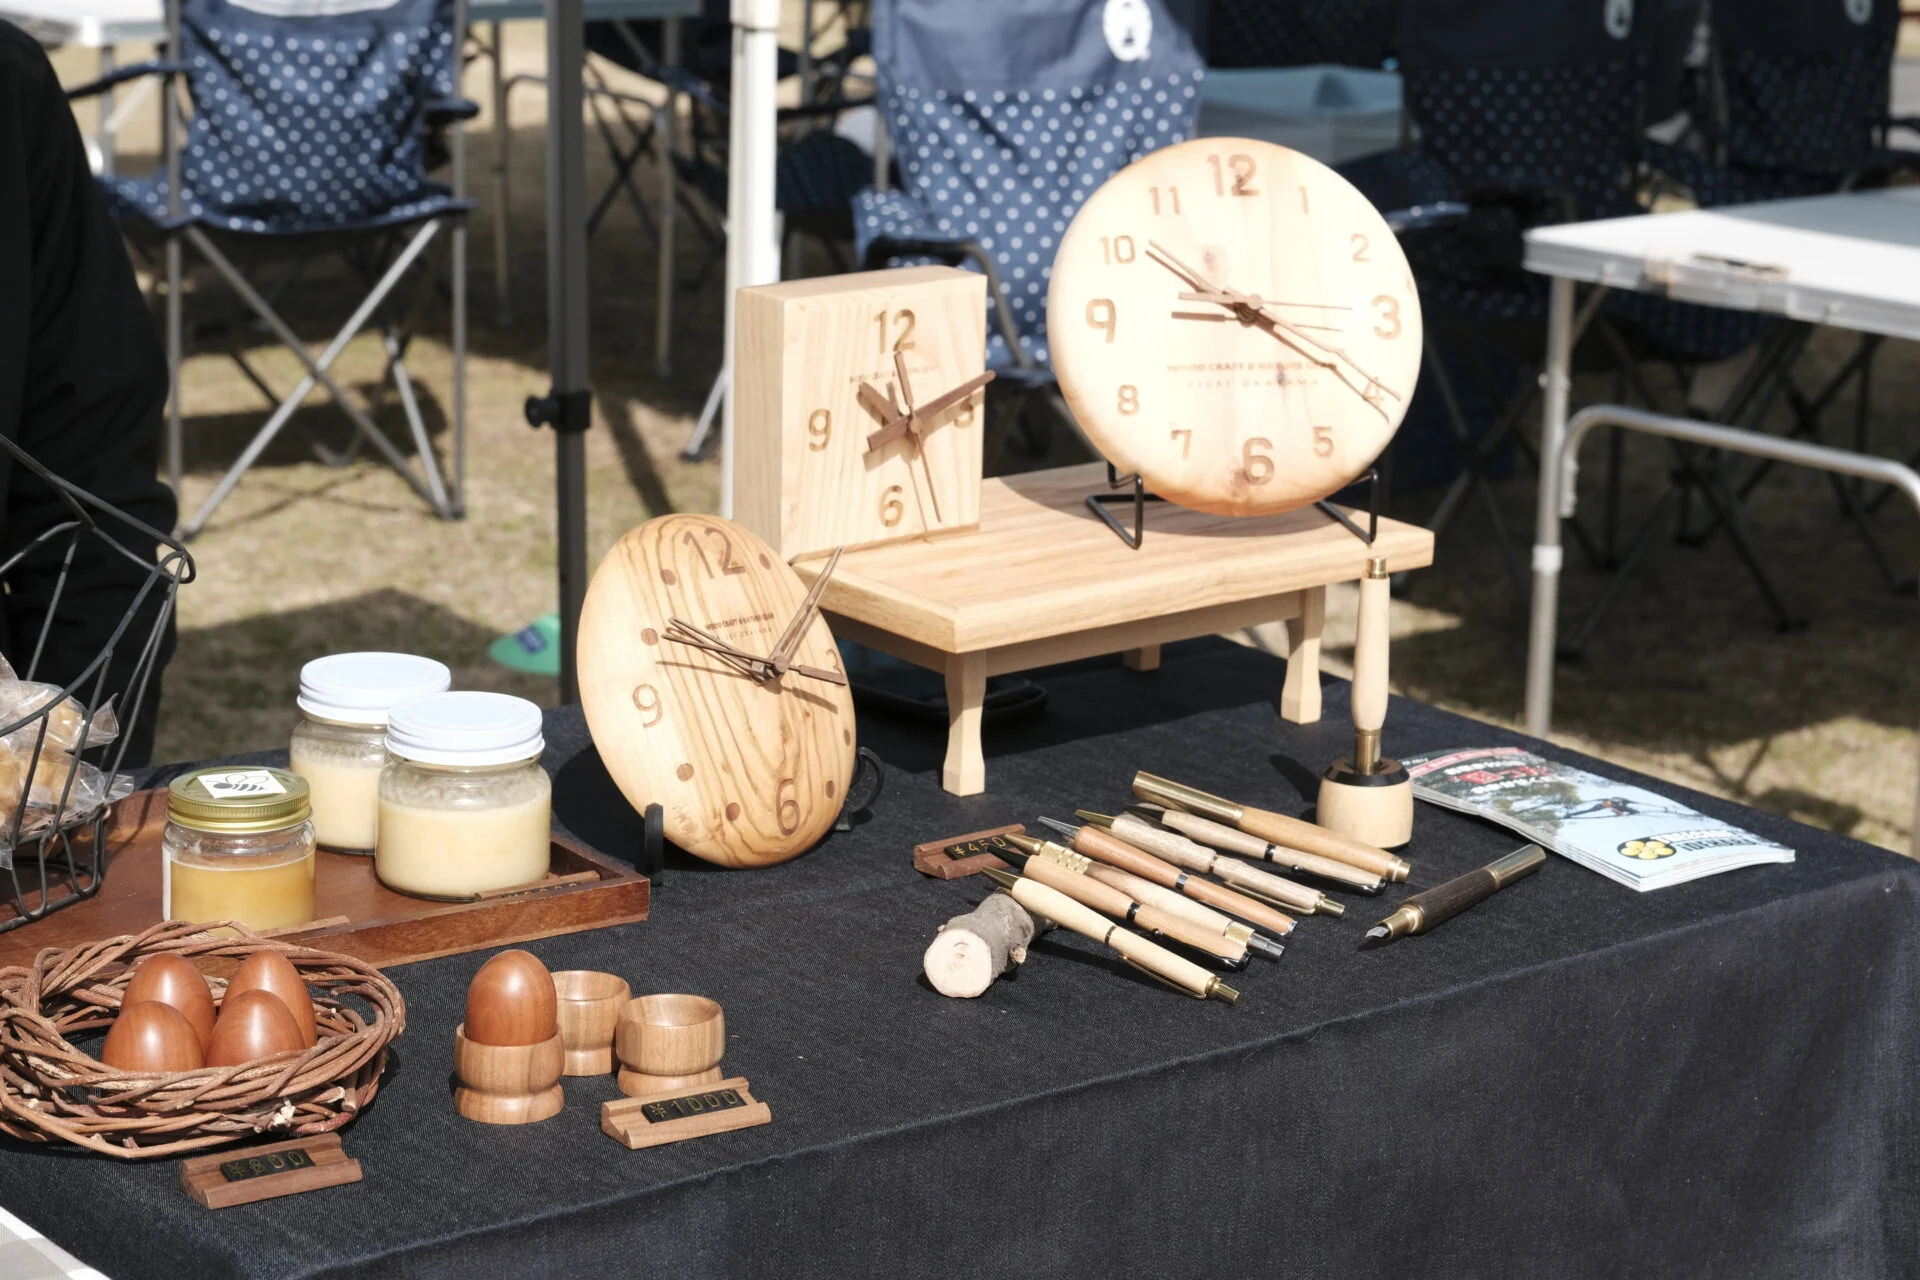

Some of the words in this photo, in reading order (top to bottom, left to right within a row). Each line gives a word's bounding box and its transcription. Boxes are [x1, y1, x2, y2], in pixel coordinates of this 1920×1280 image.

[1206, 154, 1260, 197] 12
[1149, 186, 1180, 216] 11
[1297, 186, 1309, 214] 1
[1099, 235, 1136, 264] 10
[1351, 233, 1370, 262] 2
[873, 308, 916, 354] 12
[1085, 298, 1116, 344] 9
[1371, 294, 1402, 340] 3
[1117, 384, 1140, 416] 8
[808, 408, 832, 452] 9
[1171, 429, 1192, 460] 7
[1312, 426, 1334, 458] 5
[1242, 437, 1275, 485] 6
[878, 485, 904, 528] 6
[682, 526, 746, 579] 12
[632, 683, 663, 729] 9
[775, 778, 801, 836] 6
[649, 1091, 739, 1118] ¥1000
